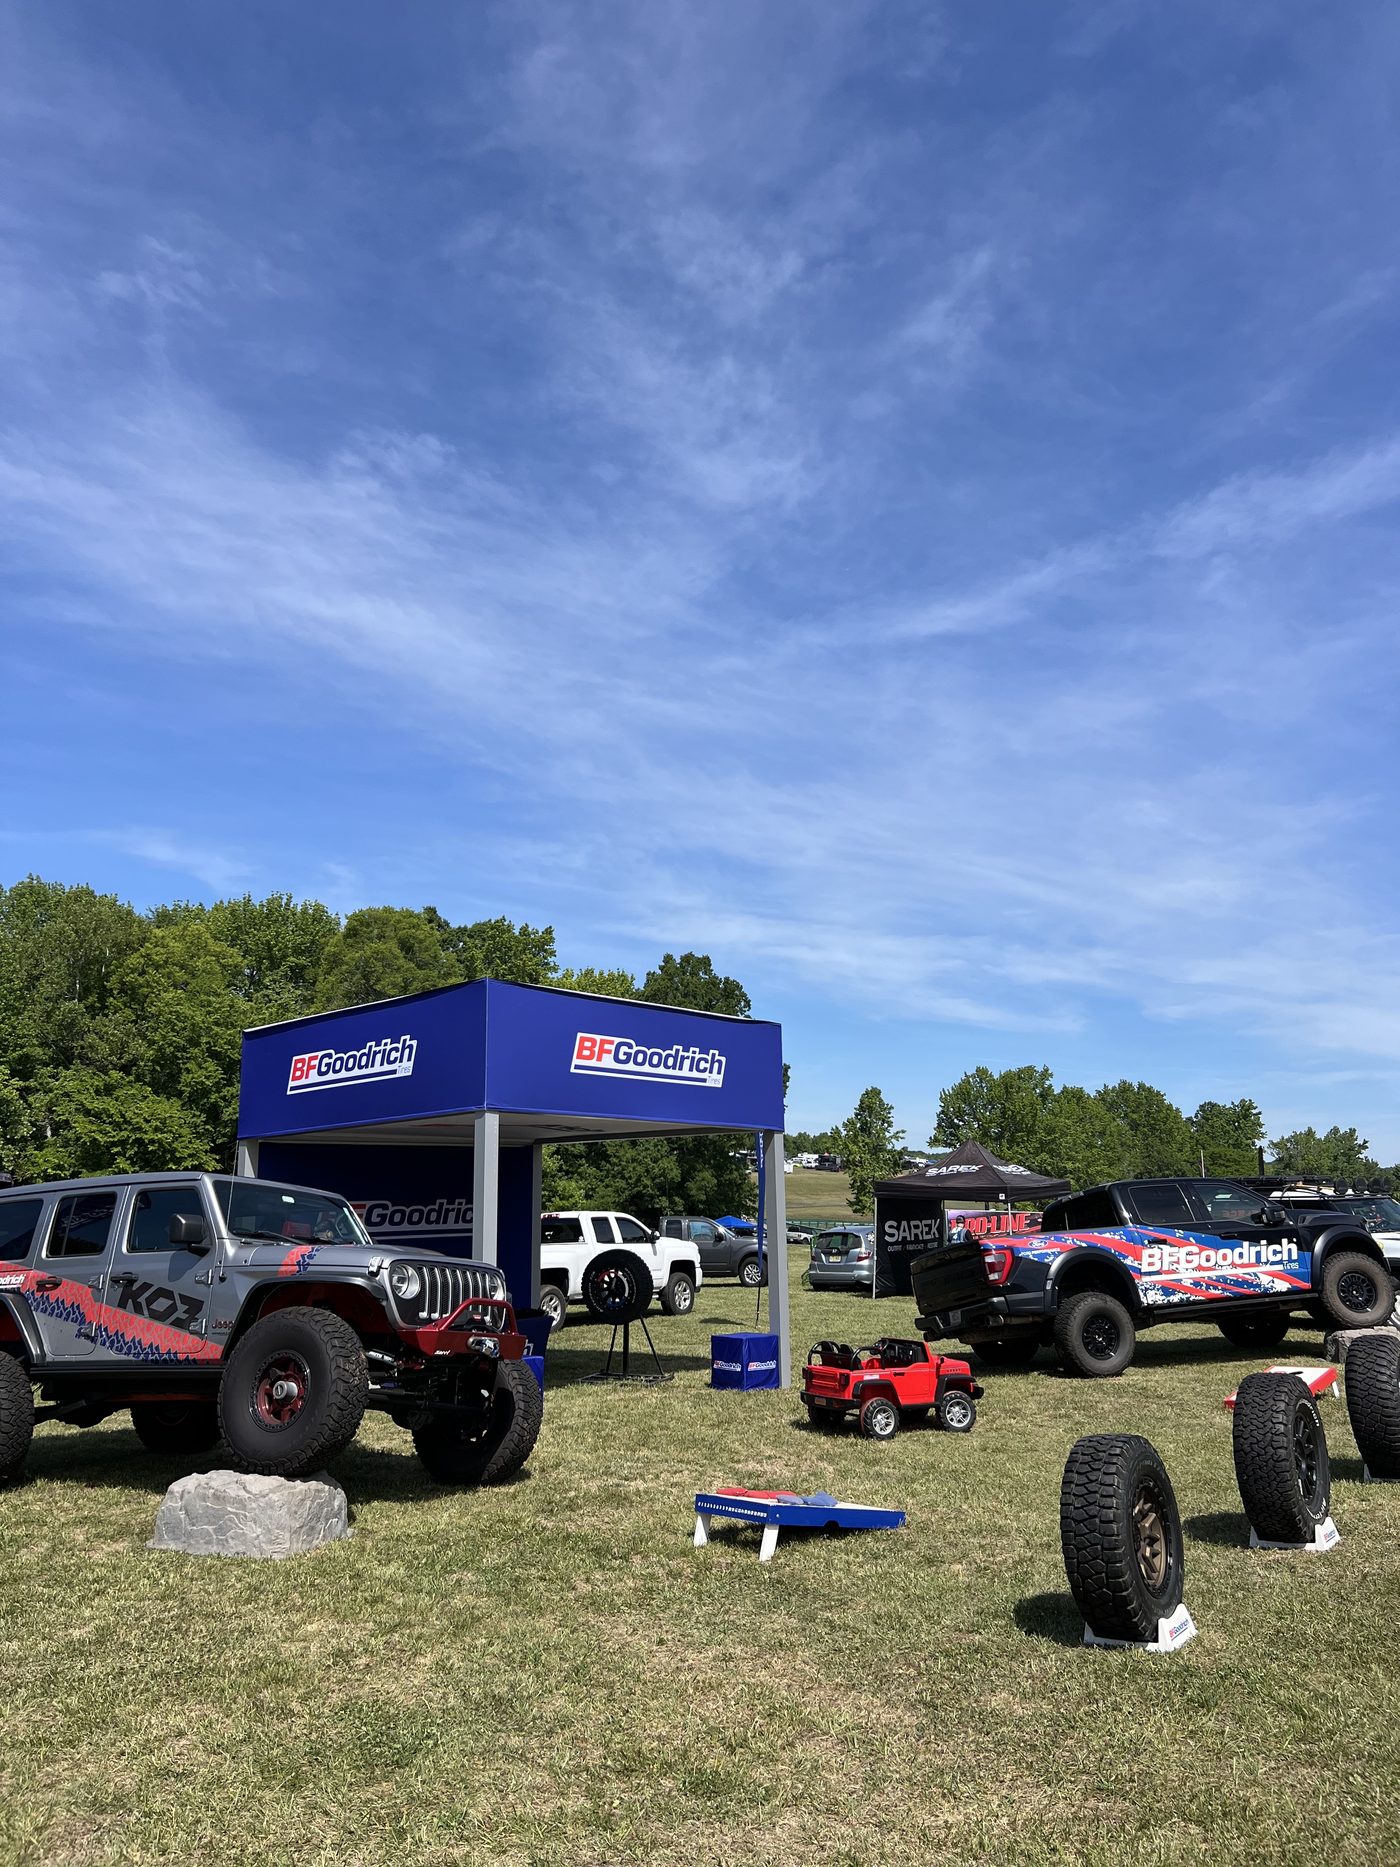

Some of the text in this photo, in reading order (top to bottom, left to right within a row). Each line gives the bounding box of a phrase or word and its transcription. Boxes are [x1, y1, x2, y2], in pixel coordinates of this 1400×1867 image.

[291, 1037, 414, 1082] BFGoodrich
[575, 1036, 723, 1075] BFGoodrich
[397, 1065, 411, 1075] Tires
[707, 1076, 721, 1085] Tires
[884, 1218, 940, 1242] SAREK
[1141, 1238, 1298, 1273] BFGoodrich
[1283, 1261, 1299, 1270] Tires
